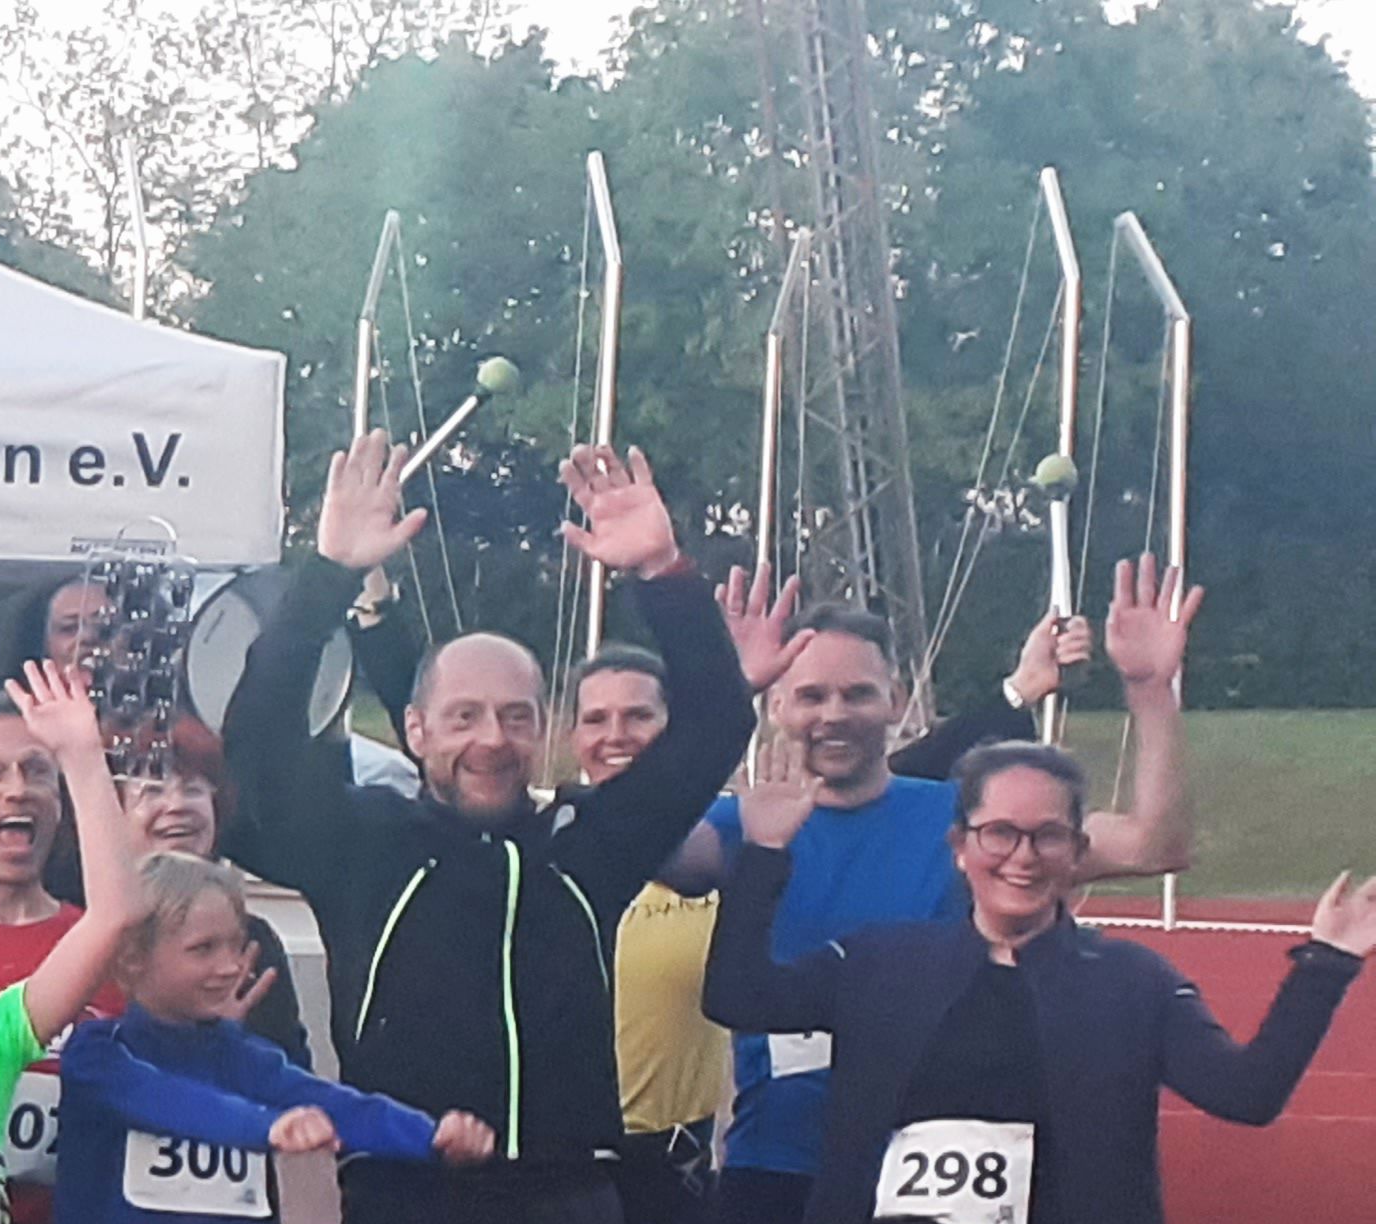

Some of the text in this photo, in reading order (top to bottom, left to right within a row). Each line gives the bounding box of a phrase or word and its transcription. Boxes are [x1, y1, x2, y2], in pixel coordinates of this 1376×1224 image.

[69, 432, 190, 488] e.V.
[149, 1137, 248, 1182] 300
[896, 1150, 1008, 1199] 298
